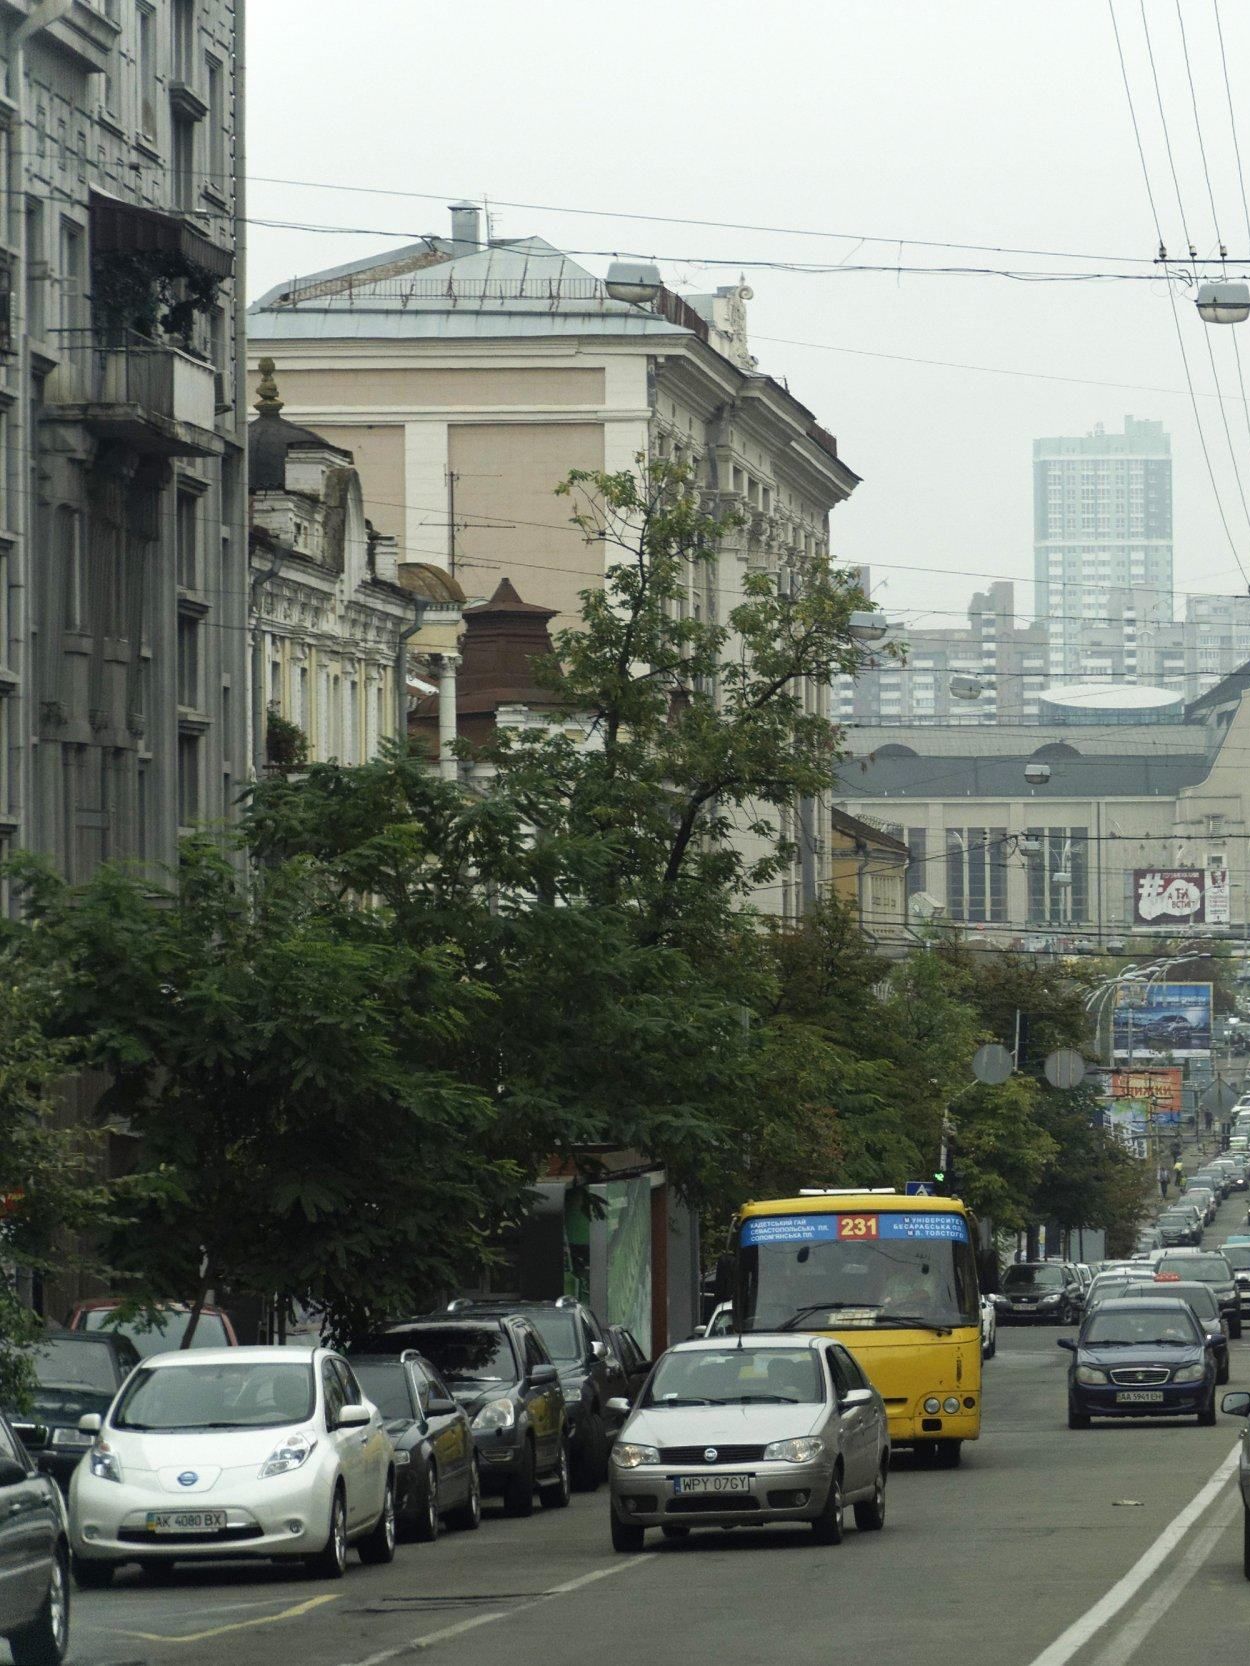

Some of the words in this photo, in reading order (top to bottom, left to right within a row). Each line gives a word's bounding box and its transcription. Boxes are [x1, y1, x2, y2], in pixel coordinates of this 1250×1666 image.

[841, 1218, 877, 1236] 231
[683, 1478, 709, 1492] WPY
[204, 1513, 221, 1527] BX
